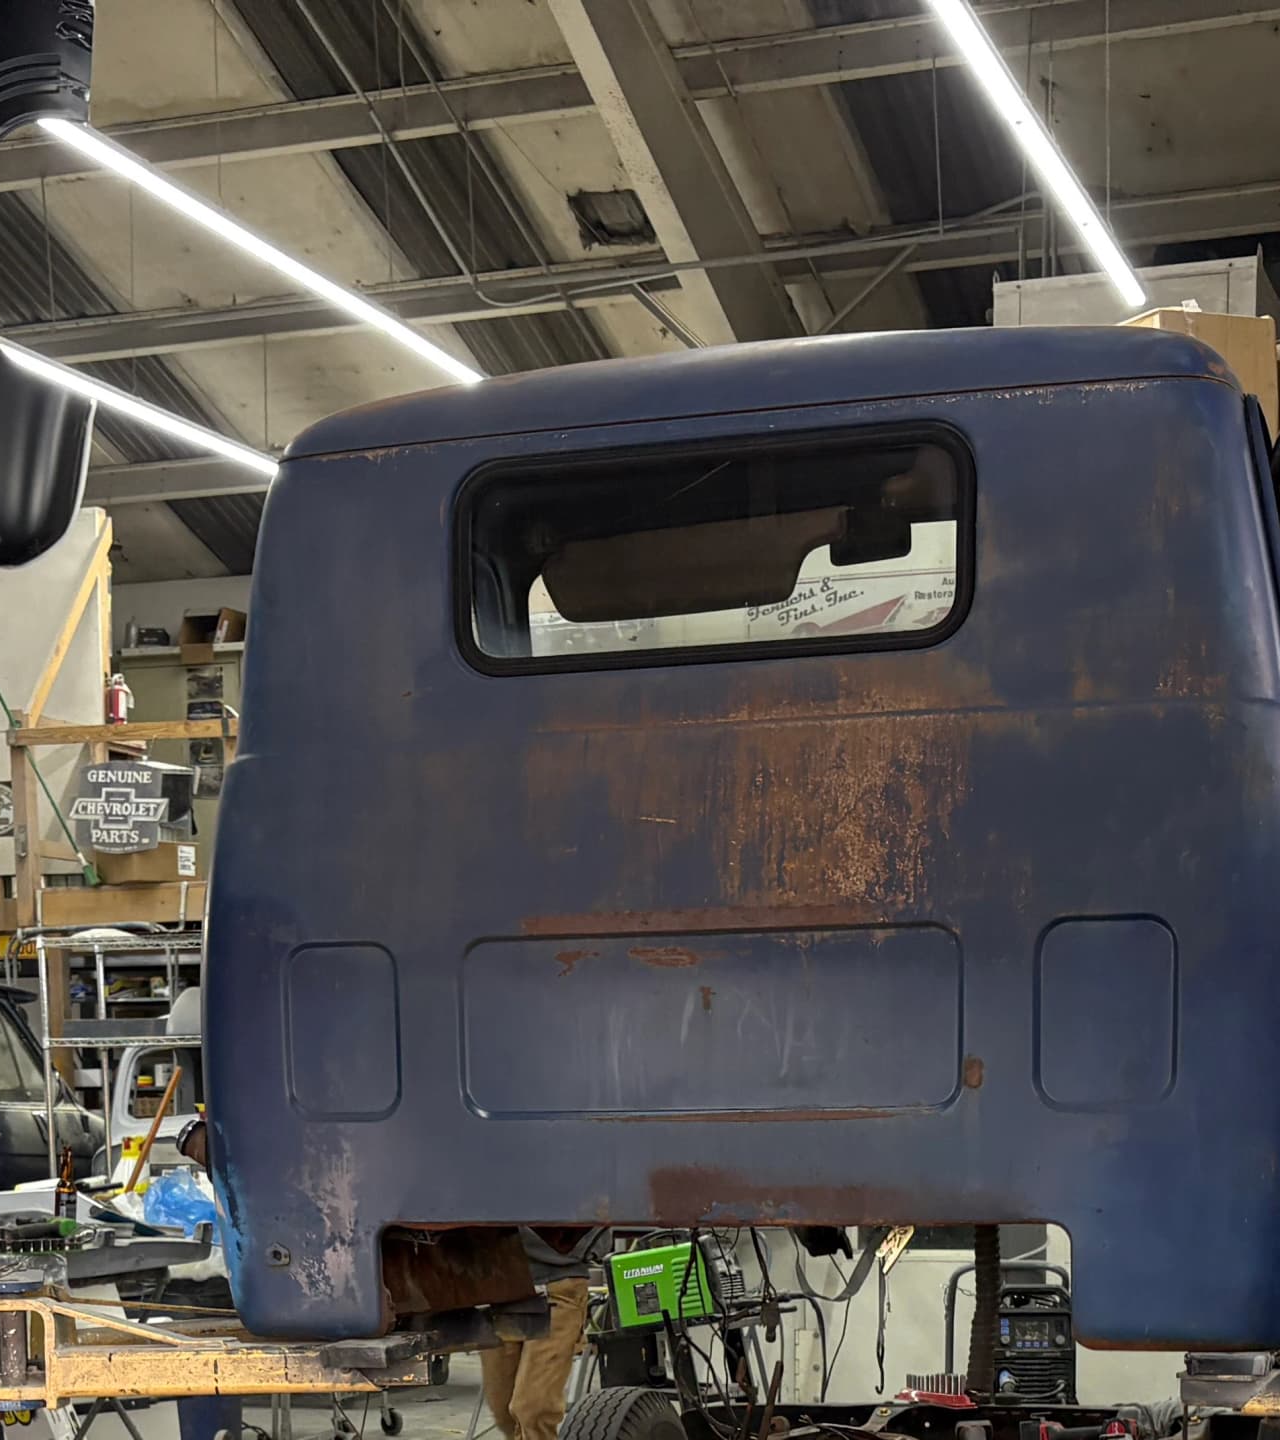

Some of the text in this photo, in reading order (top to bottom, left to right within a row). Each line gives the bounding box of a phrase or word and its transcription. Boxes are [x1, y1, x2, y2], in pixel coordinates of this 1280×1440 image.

[820, 577, 834, 593] &
[87, 770, 153, 784] GENUINE
[78, 802, 158, 817] CHEVROLET
[91, 829, 139, 844] PARTS
